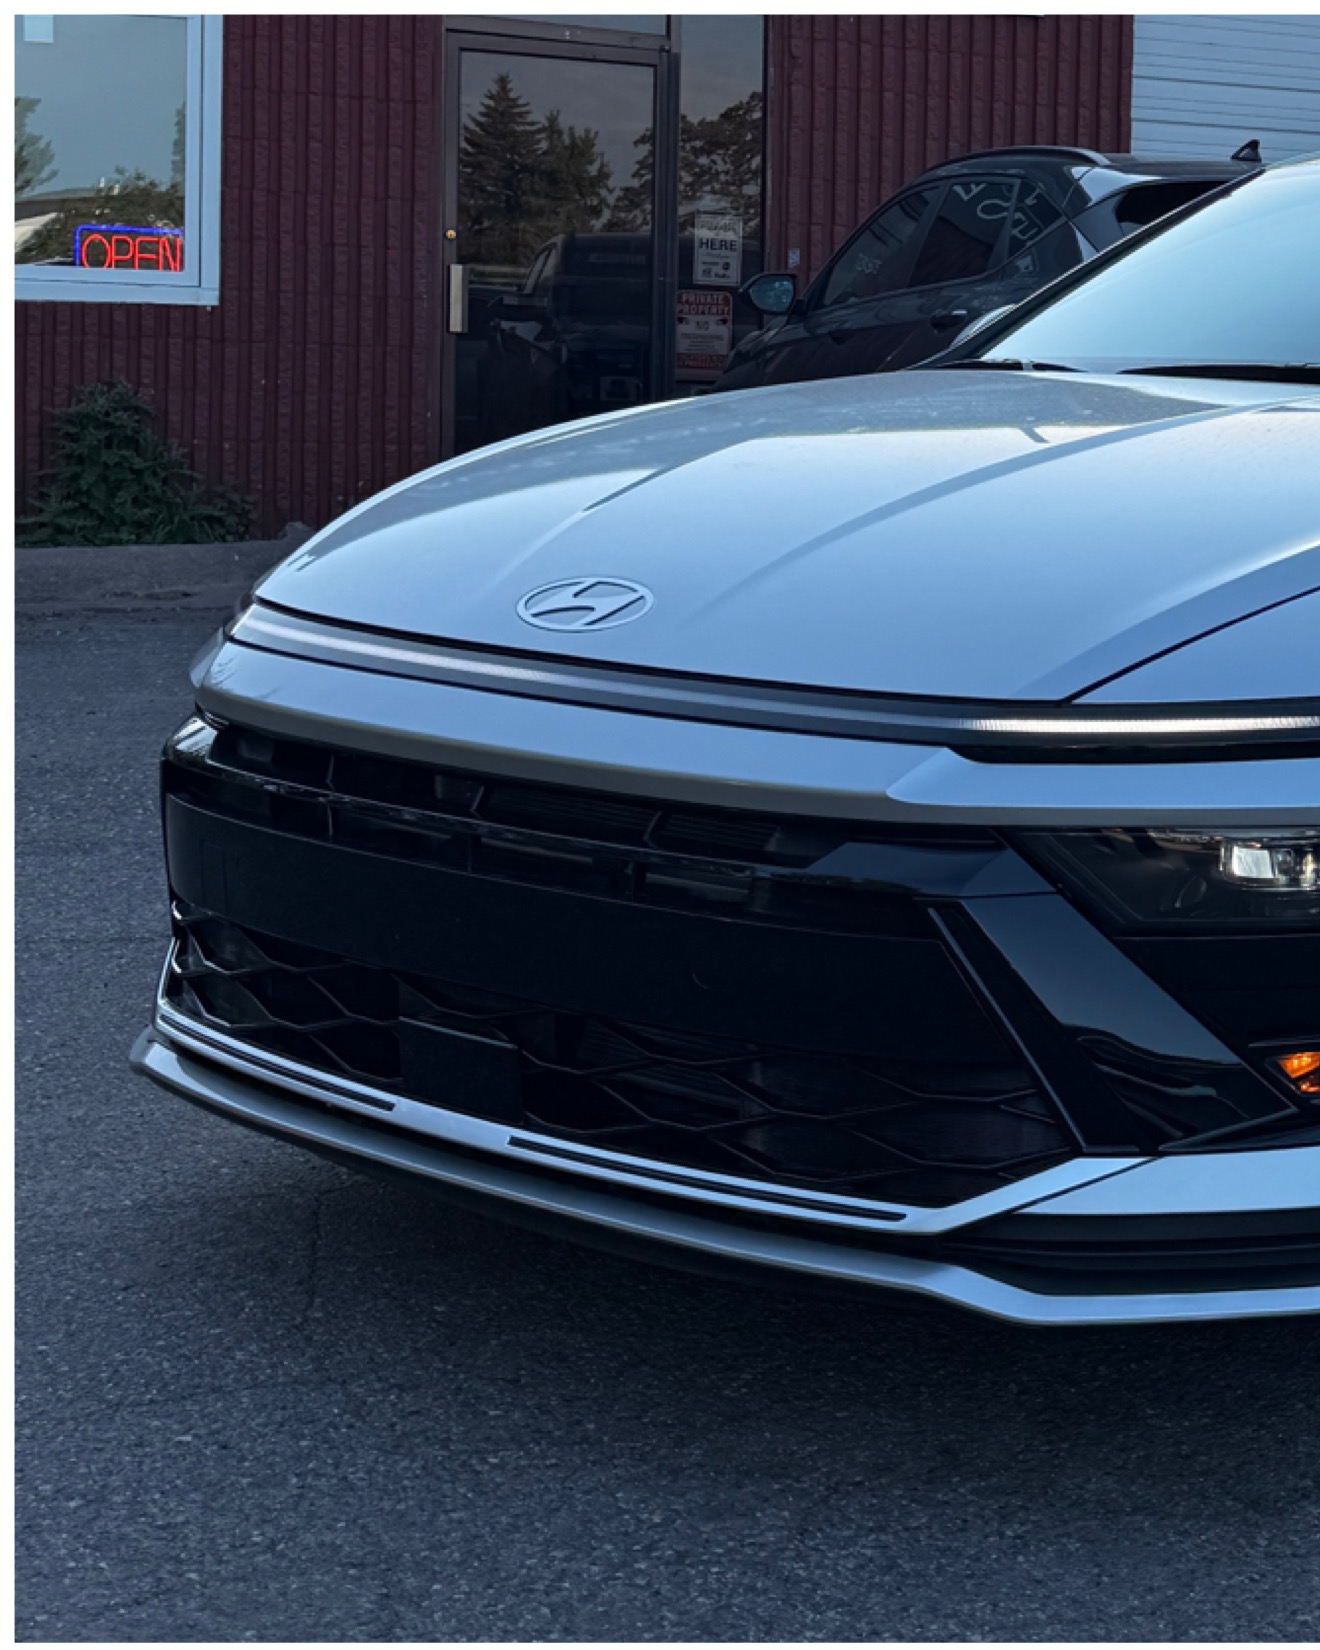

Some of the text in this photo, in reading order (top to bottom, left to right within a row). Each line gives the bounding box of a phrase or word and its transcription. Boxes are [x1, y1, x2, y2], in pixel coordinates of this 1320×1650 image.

[699, 238, 737, 252] HERE
[81, 233, 181, 272] OPEN
[682, 292, 724, 305] PRIVATE
[677, 303, 730, 316] PROPERTY
